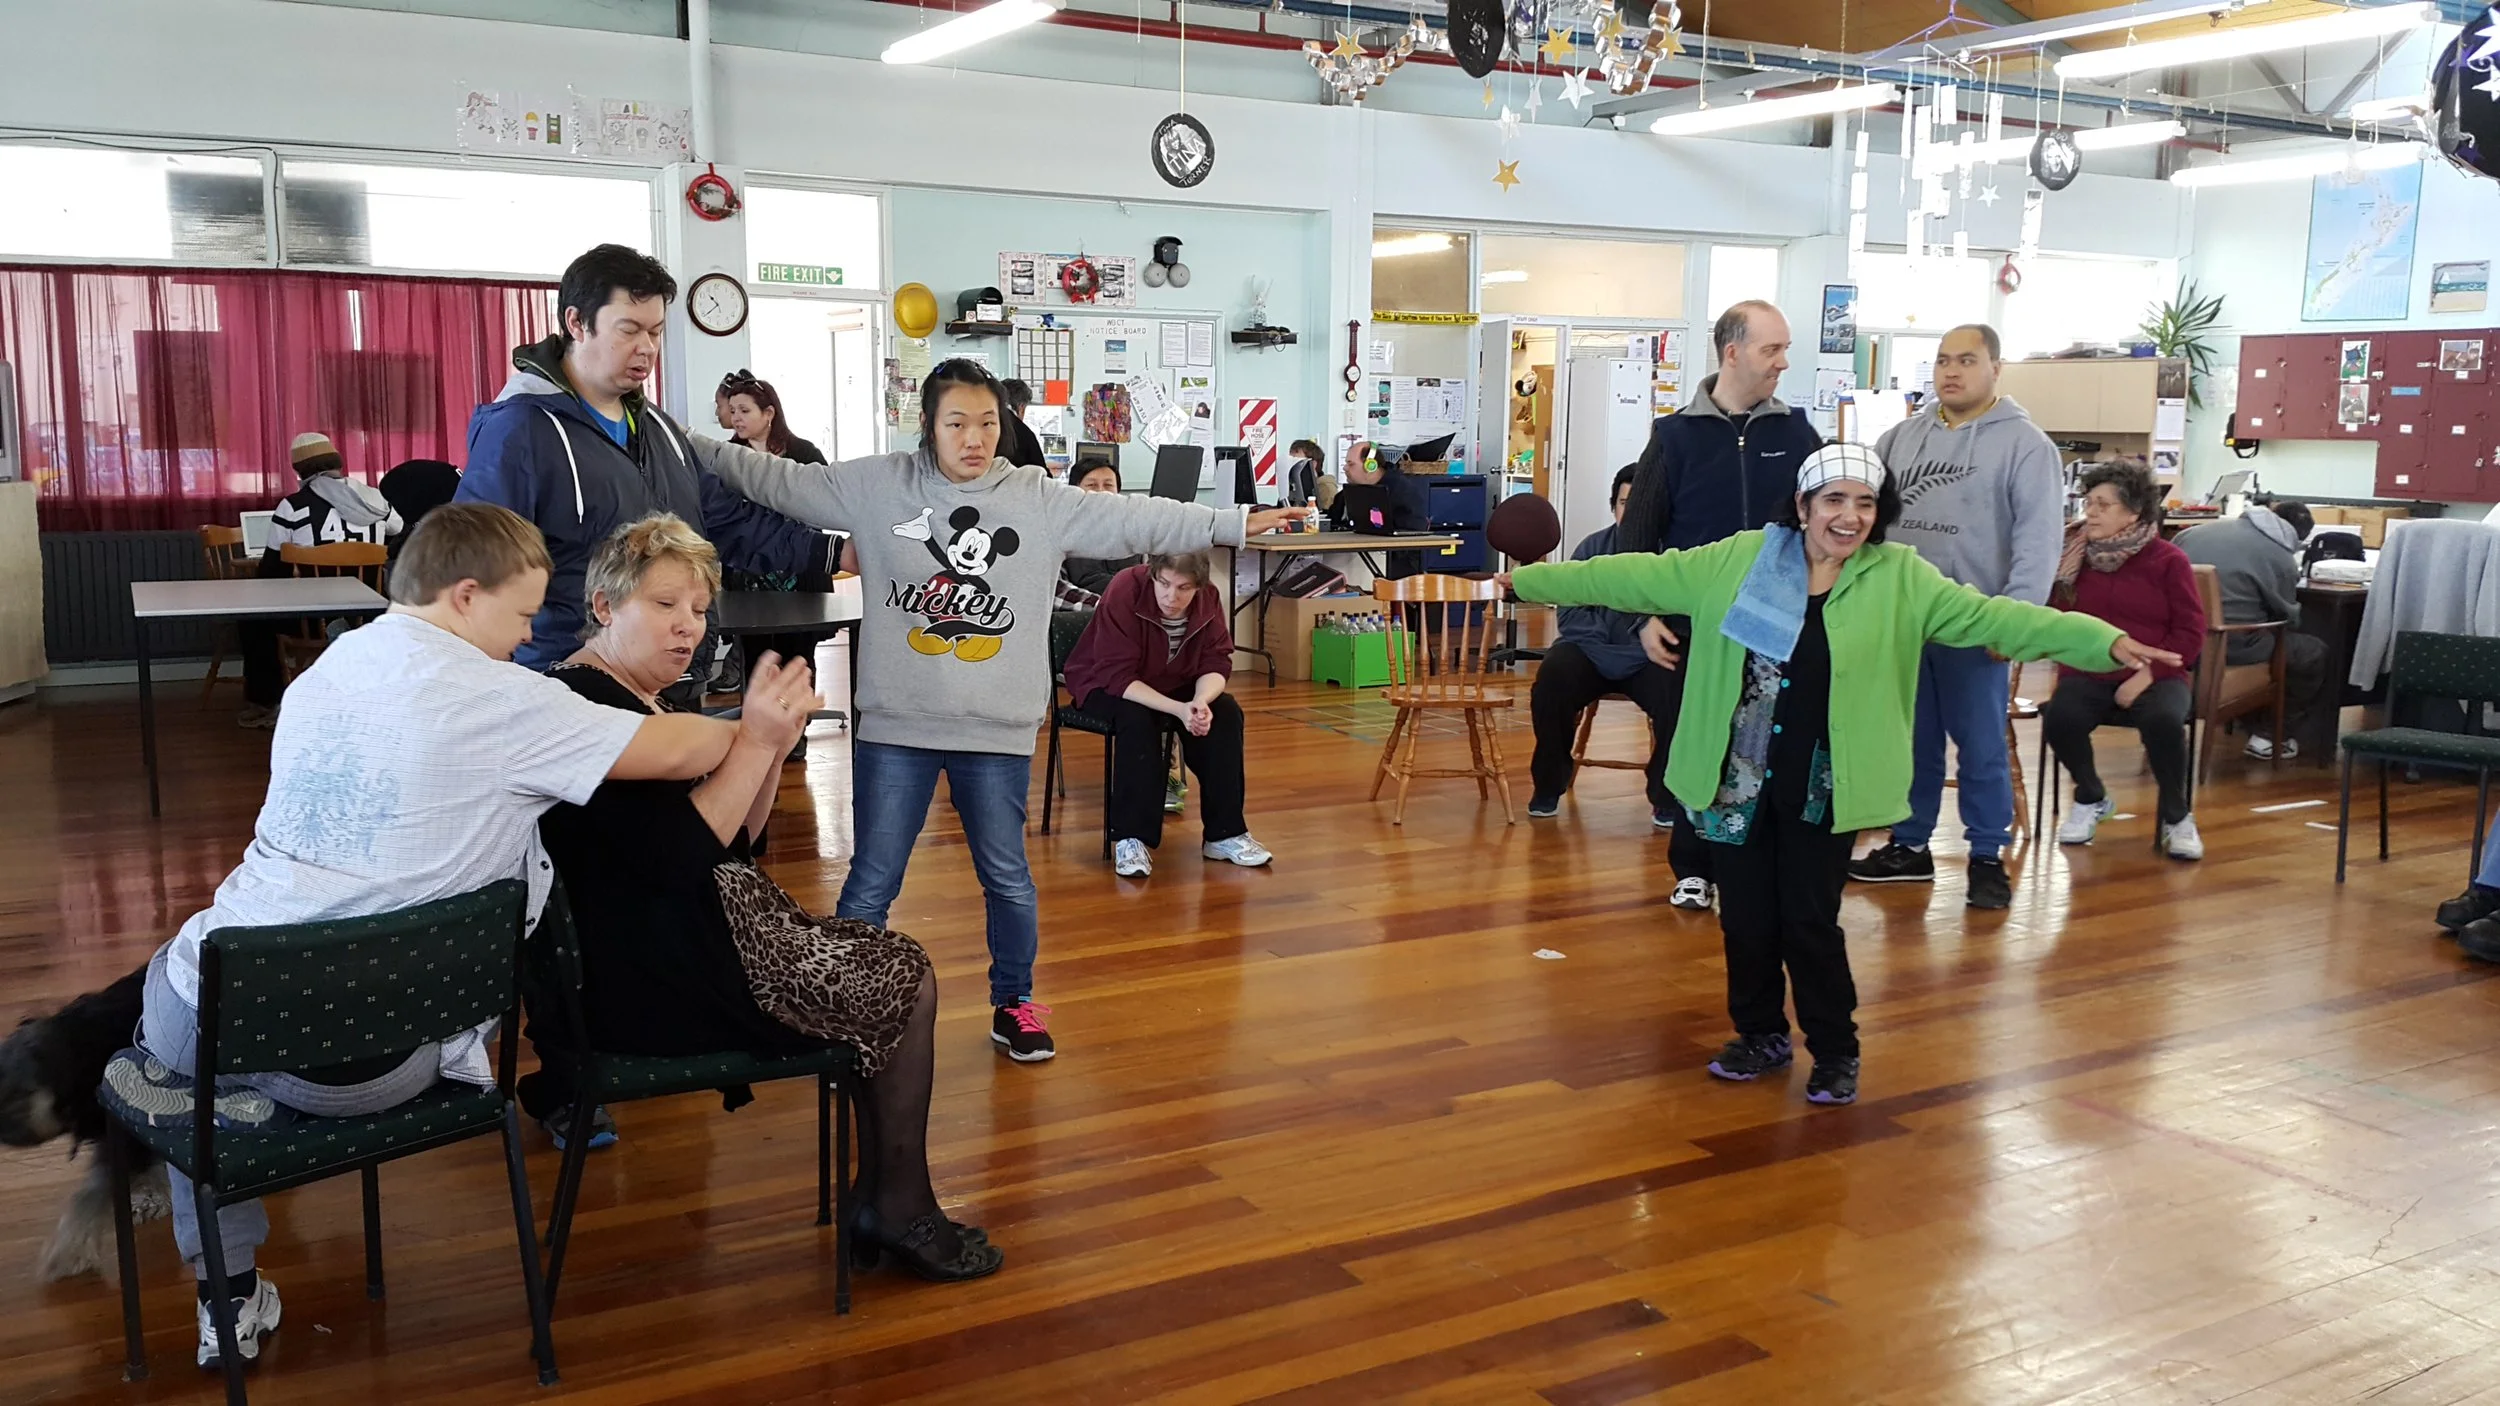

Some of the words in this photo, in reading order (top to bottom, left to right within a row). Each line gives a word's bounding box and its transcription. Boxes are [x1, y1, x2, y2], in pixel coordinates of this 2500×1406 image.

[1168, 137, 1207, 171] TINA
[1178, 155, 1212, 186] TURNER
[760, 264, 788, 281] FIRE
[793, 266, 822, 283] EXIT
[1089, 327, 1118, 335] NOTICE
[1123, 327, 1147, 335] BOARD
[1901, 519, 1960, 535] ZEALAND
[885, 578, 1011, 627] Mickey
